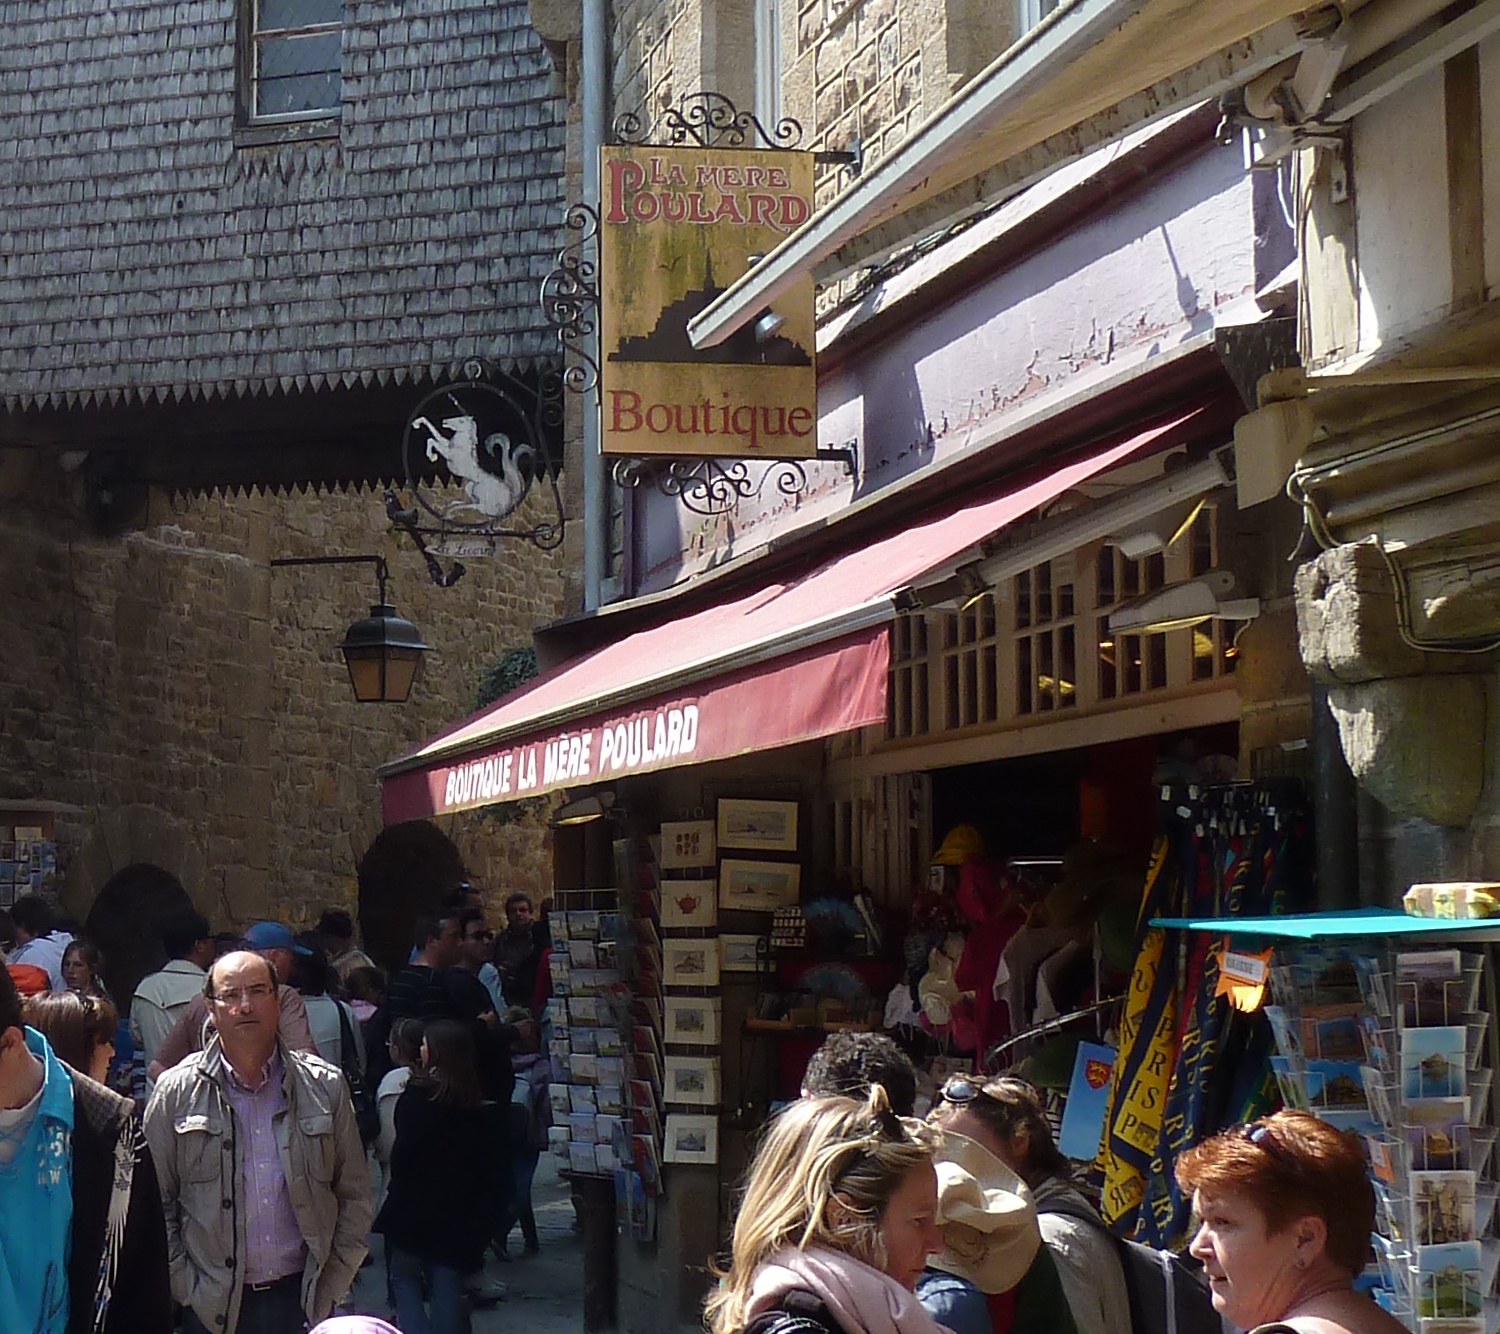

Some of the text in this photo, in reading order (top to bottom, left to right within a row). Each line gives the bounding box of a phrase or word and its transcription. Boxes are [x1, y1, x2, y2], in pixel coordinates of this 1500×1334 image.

[606, 159, 810, 231] POULARD
[697, 165, 790, 192] MERE
[607, 390, 814, 448] Boutique
[445, 705, 699, 806] BOUTIQUE LA MÈRE POULARD
